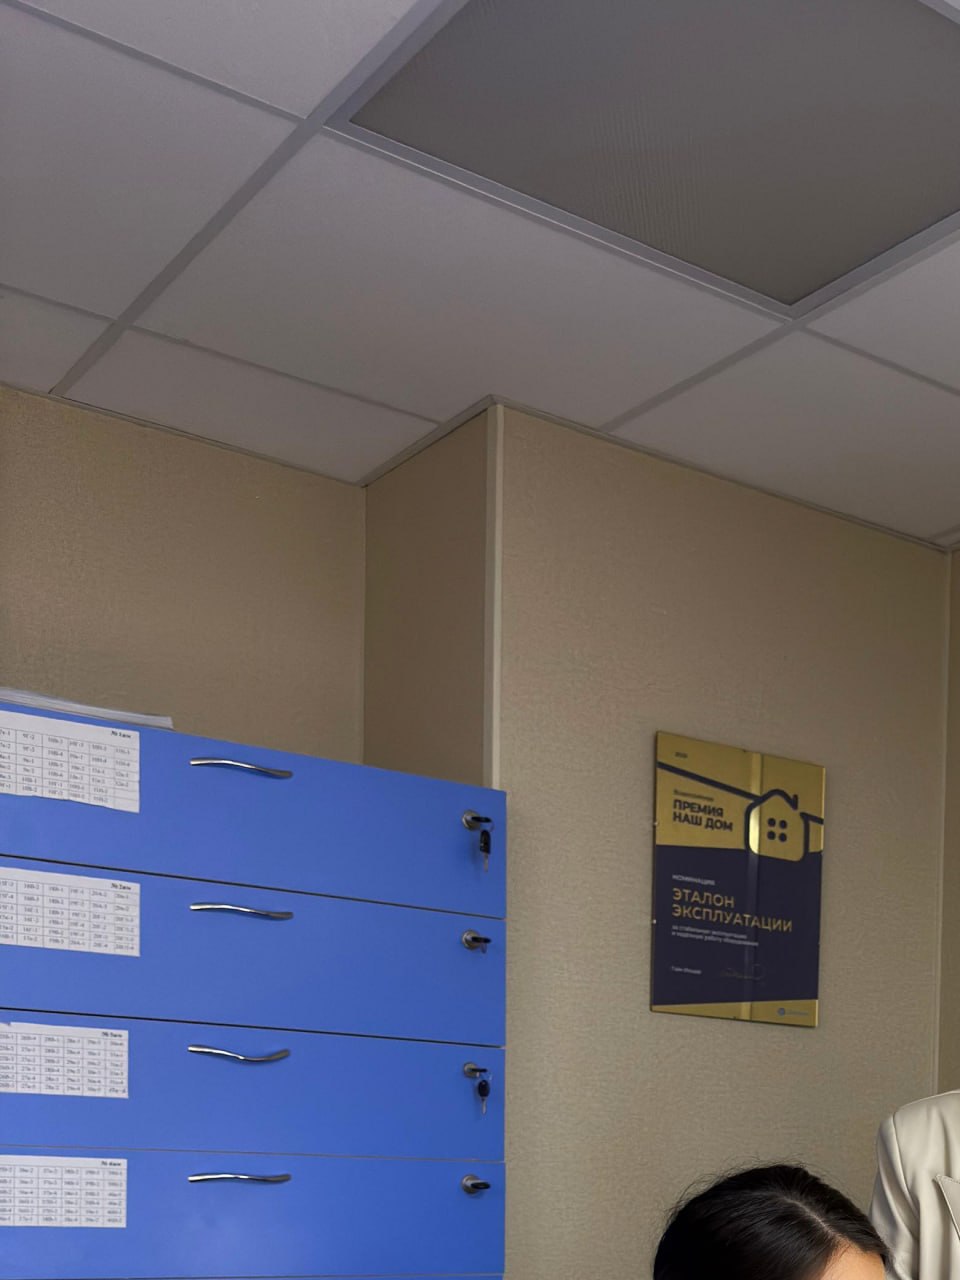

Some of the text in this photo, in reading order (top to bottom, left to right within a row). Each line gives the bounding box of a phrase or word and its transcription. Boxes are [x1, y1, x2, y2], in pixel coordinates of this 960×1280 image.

[673, 798, 724, 817] ПРЕМИЯ
[673, 811, 733, 832] НАШ ДОМ
[672, 888, 735, 908] ЭТАЛОН
[672, 904, 792, 932] ЭКСПЛУАТАЦИИ
